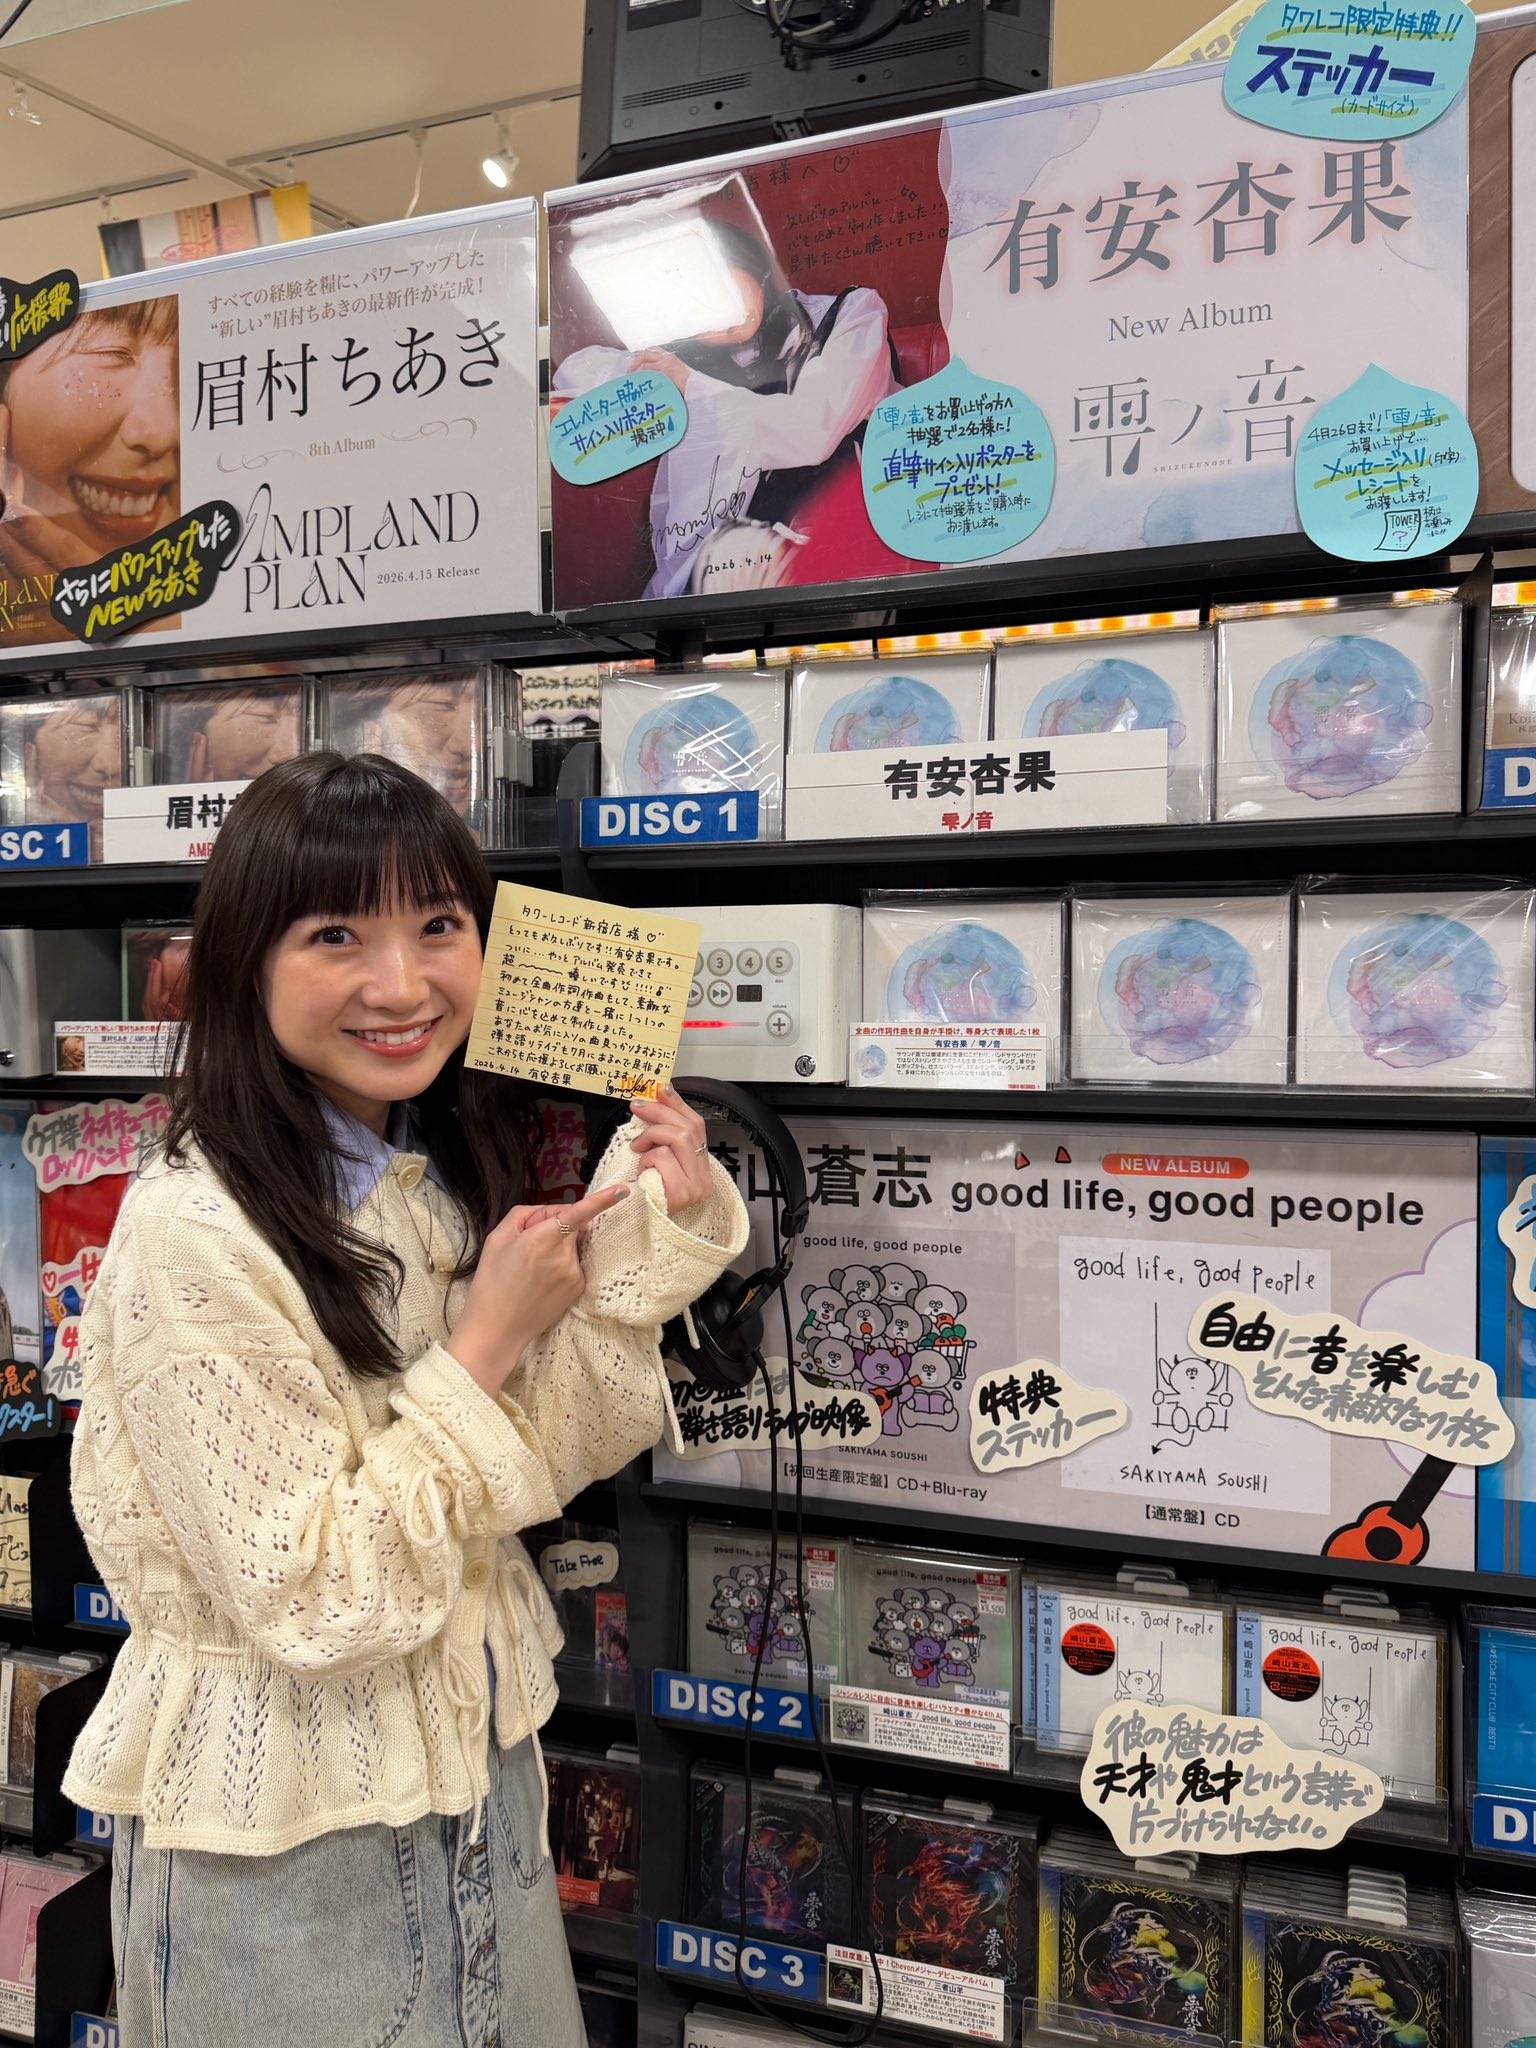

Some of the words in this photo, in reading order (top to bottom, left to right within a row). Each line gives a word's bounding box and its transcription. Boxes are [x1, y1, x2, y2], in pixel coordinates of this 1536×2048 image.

[1282, 1, 1463, 41] タワレコ限定特典!!
[1246, 45, 1435, 96] ステッカー
[983, 140, 1413, 295] 有安杏果
[208, 248, 486, 312] すべての経験を糧に、パワーアップした
[1108, 315, 1170, 341] New
[1179, 300, 1274, 331] Album
[191, 316, 506, 432] 眉村ちあき
[569, 402, 666, 454] サイン入りポスター
[630, 420, 666, 447] 掲示中
[1069, 359, 1316, 477] 雫ノ音
[308, 442, 331, 457] 8th
[333, 436, 376, 455] Album
[882, 440, 1036, 489] 直筆サイン入りポスターを
[934, 473, 1001, 503] プレゼント!
[1357, 471, 1421, 496] レシートを
[221, 482, 482, 571] AMPLAND
[55, 509, 232, 616] さらにパワーアップした
[377, 567, 433, 586] 2026.4.15
[437, 564, 481, 580] Release
[85, 557, 204, 638] NEWちあき
[242, 554, 367, 614] PLAN
[884, 750, 1056, 800] 有安杏果
[166, 793, 241, 830] 眉村
[598, 800, 702, 838] DISC
[719, 798, 738, 833] 1
[55, 829, 71, 858] 1
[716, 958, 723, 968] 3
[745, 957, 753, 968] 4
[776, 957, 783, 968] 5
[934, 1040, 968, 1048] 有安杏果
[528, 1068, 573, 1087] 有安杏果
[1119, 1157, 1161, 1172] NEW
[1164, 1158, 1231, 1175] ALBUM
[951, 1179, 1049, 1212] good
[1063, 1179, 1137, 1220] life,
[1149, 1186, 1256, 1223] good
[1271, 1192, 1425, 1231] people
[803, 1236, 838, 1248] good
[842, 1236, 868, 1250] life,
[873, 1239, 907, 1251] good
[913, 1241, 963, 1255] people
[1074, 1254, 1126, 1280] good
[1137, 1256, 1184, 1287] life,
[1194, 1258, 1241, 1287] good
[1200, 1302, 1480, 1401] 自由に音を楽しむ
[0, 1364, 37, 1399] 急ぐ
[979, 1370, 1063, 1427] 特典
[838, 1446, 888, 1458] SAKIYAMA
[890, 1450, 929, 1462] SOUSHI
[976, 1408, 1118, 1466] ステッカー
[1119, 1464, 1207, 1488] SAKIYAMA
[1142, 1504, 1206, 1528] 【通常盤】
[1214, 1514, 1241, 1529] CD
[549, 1558, 577, 1574] Take
[579, 1554, 604, 1568] Free
[1067, 1605, 1099, 1622] good
[1141, 1610, 1169, 1630] good
[1269, 1627, 1303, 1645] good
[1349, 1634, 1378, 1655] good
[670, 1679, 765, 1723] DISC
[778, 1696, 803, 1728] 2
[922, 1714, 938, 1724] good
[1103, 1710, 1264, 1762] 彼の魅力は
[1093, 1752, 1373, 1811] 天才や鬼才という言葉で
[1129, 1801, 1328, 1845] 片づけられない。
[672, 1931, 767, 1980] DISC
[782, 1955, 804, 1987] 3
[834, 1949, 994, 1988] 注目度最上中!Chevonメジャーデビューアルバム!
[901, 1974, 926, 1987] Chevon
